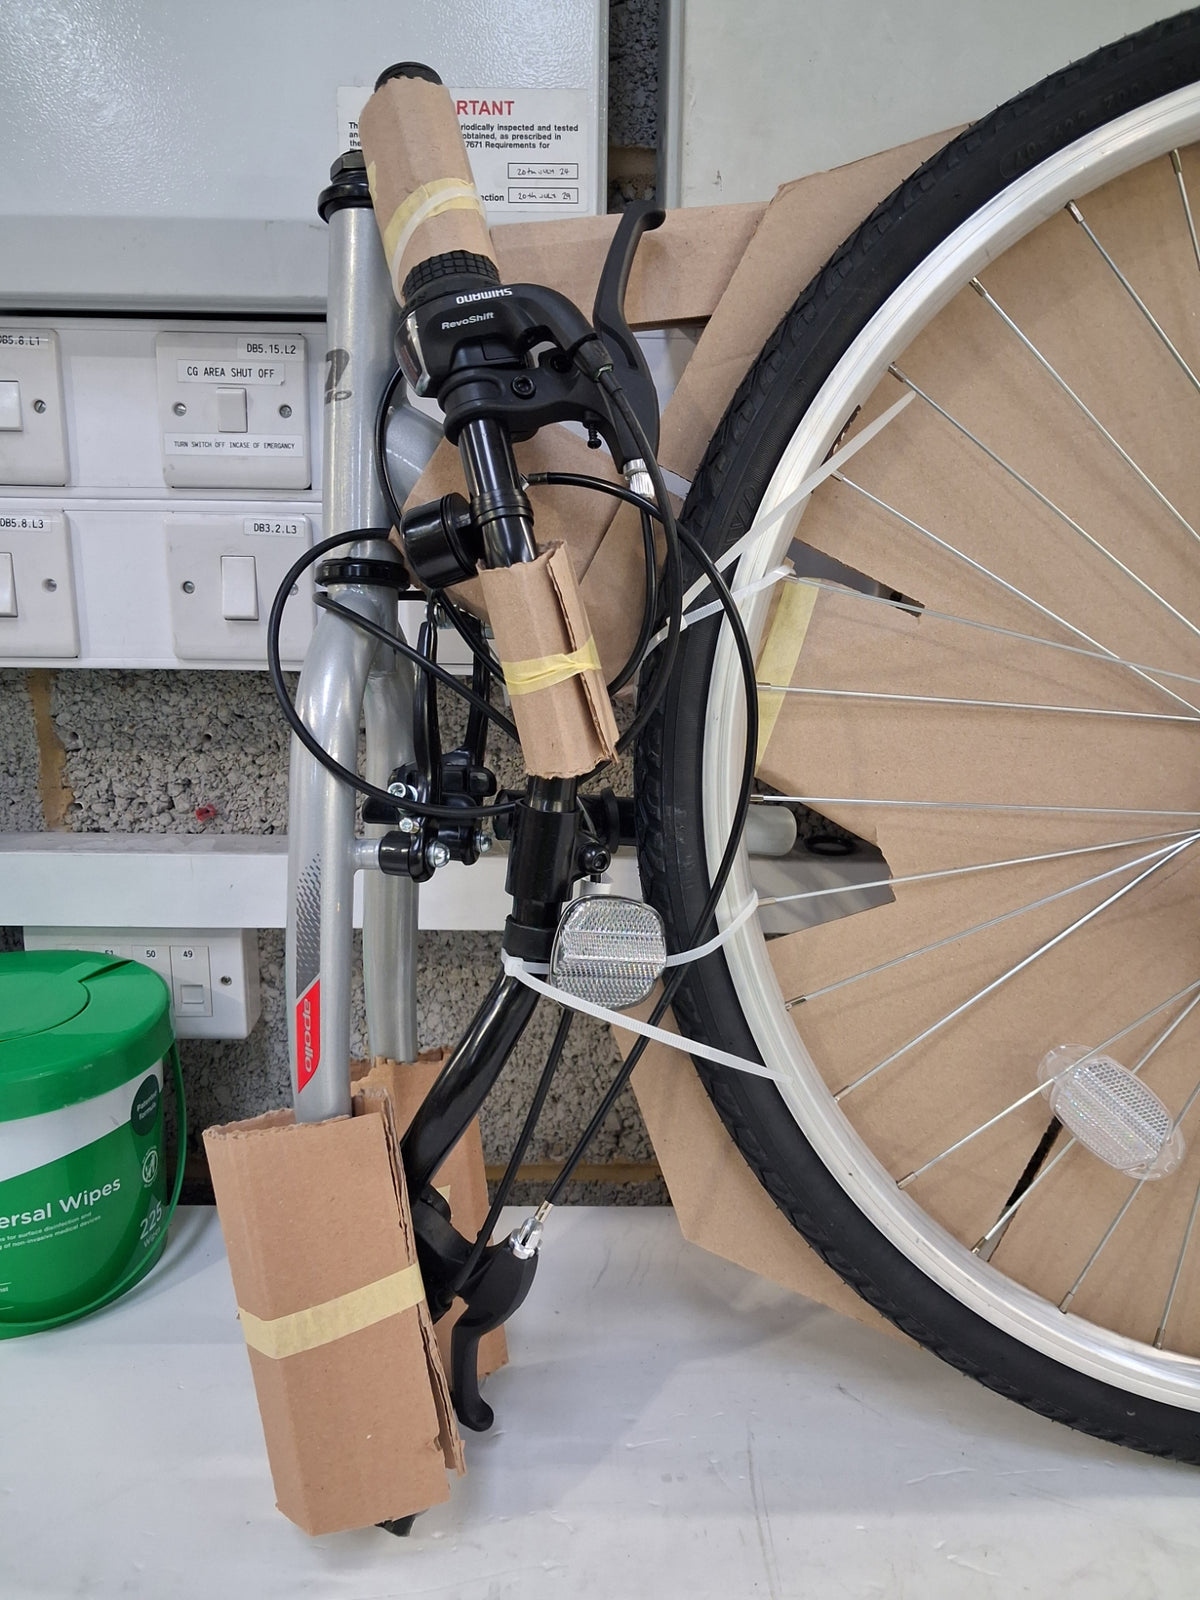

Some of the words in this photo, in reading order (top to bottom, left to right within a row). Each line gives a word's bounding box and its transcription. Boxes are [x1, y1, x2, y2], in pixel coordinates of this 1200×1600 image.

[456, 100, 515, 116] RTANT
[348, 121, 359, 129] Th
[460, 123, 494, 133] riodically
[497, 123, 535, 133] inspected
[537, 124, 551, 132] and
[554, 124, 579, 132] tested
[511, 132, 552, 142] prescribed
[485, 141, 536, 150] Requirements
[480, 193, 505, 202] ction
[456, 287, 513, 305] SHIMANO
[441, 311, 495, 331] RevoShift
[0, 334, 40, 346] B5.8.L1
[246, 343, 297, 355] DB5.15.L2
[187, 366, 198, 376] CG
[203, 367, 226, 377] AREA
[231, 368, 253, 378] SHUT
[258, 369, 275, 378] OFF
[0, 517, 44, 529] DB5.8.L3
[253, 522, 297, 534] DB3.2.L3
[146, 950, 156, 958] 50
[183, 950, 193, 958] 49
[302, 998, 314, 1072] apollo
[0, 1202, 51, 1229] ersal
[58, 1178, 121, 1214] Wipes
[140, 1200, 161, 1240] 225
[18, 1228, 43, 1239] surface
[43, 1216, 80, 1232] disinfection
[54, 1223, 79, 1236] medical
